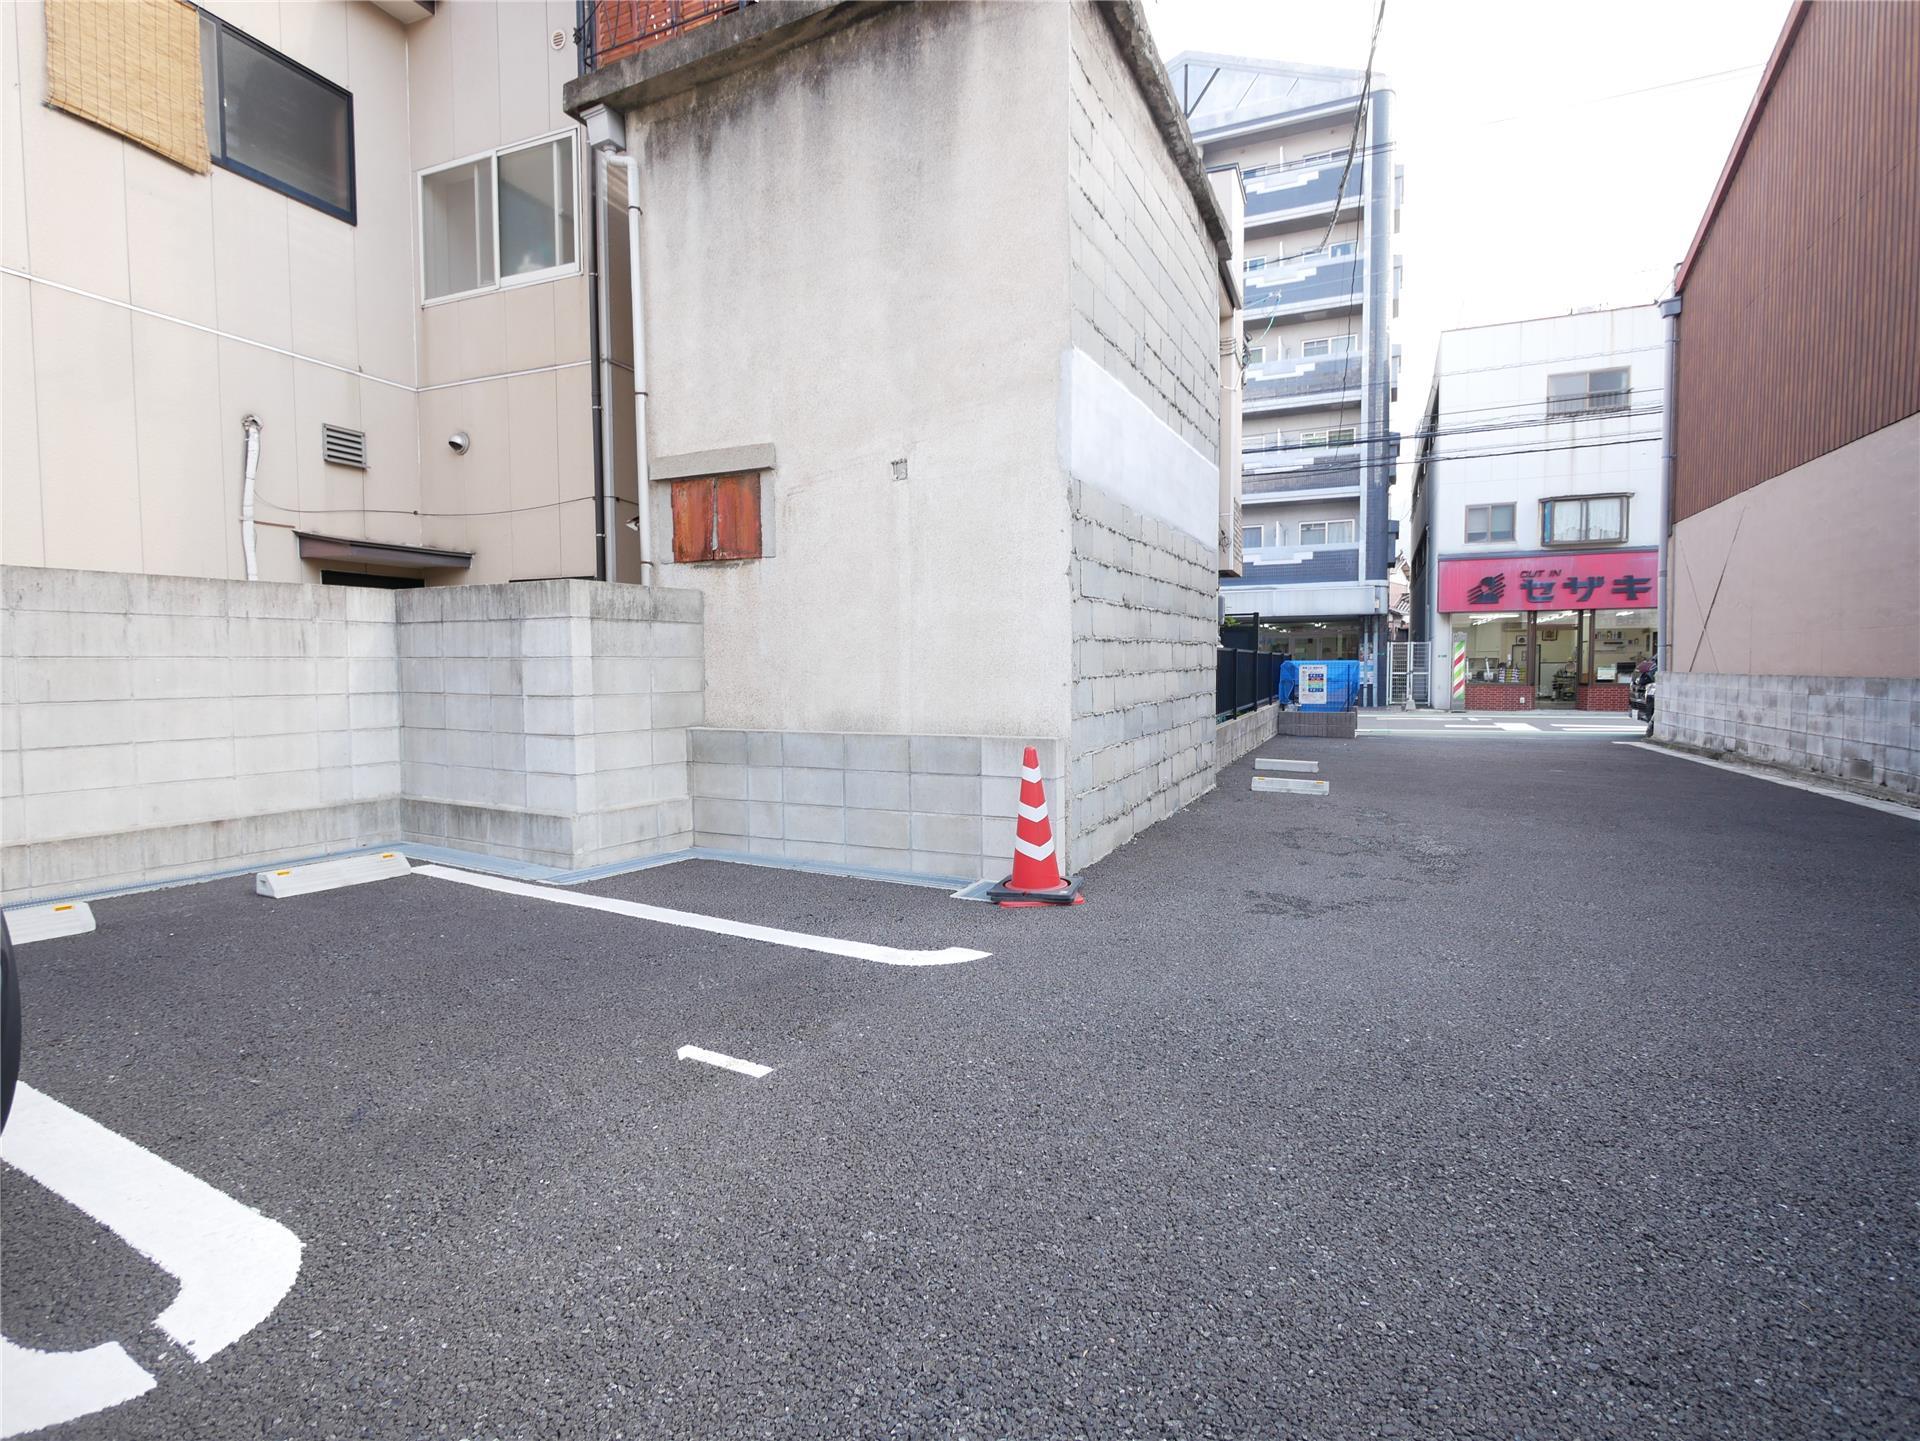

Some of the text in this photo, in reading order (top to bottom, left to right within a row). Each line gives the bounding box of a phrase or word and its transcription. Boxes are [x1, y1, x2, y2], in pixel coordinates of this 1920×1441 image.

[1548, 569, 1562, 577] IN
[1520, 576, 1652, 603] セザキ
